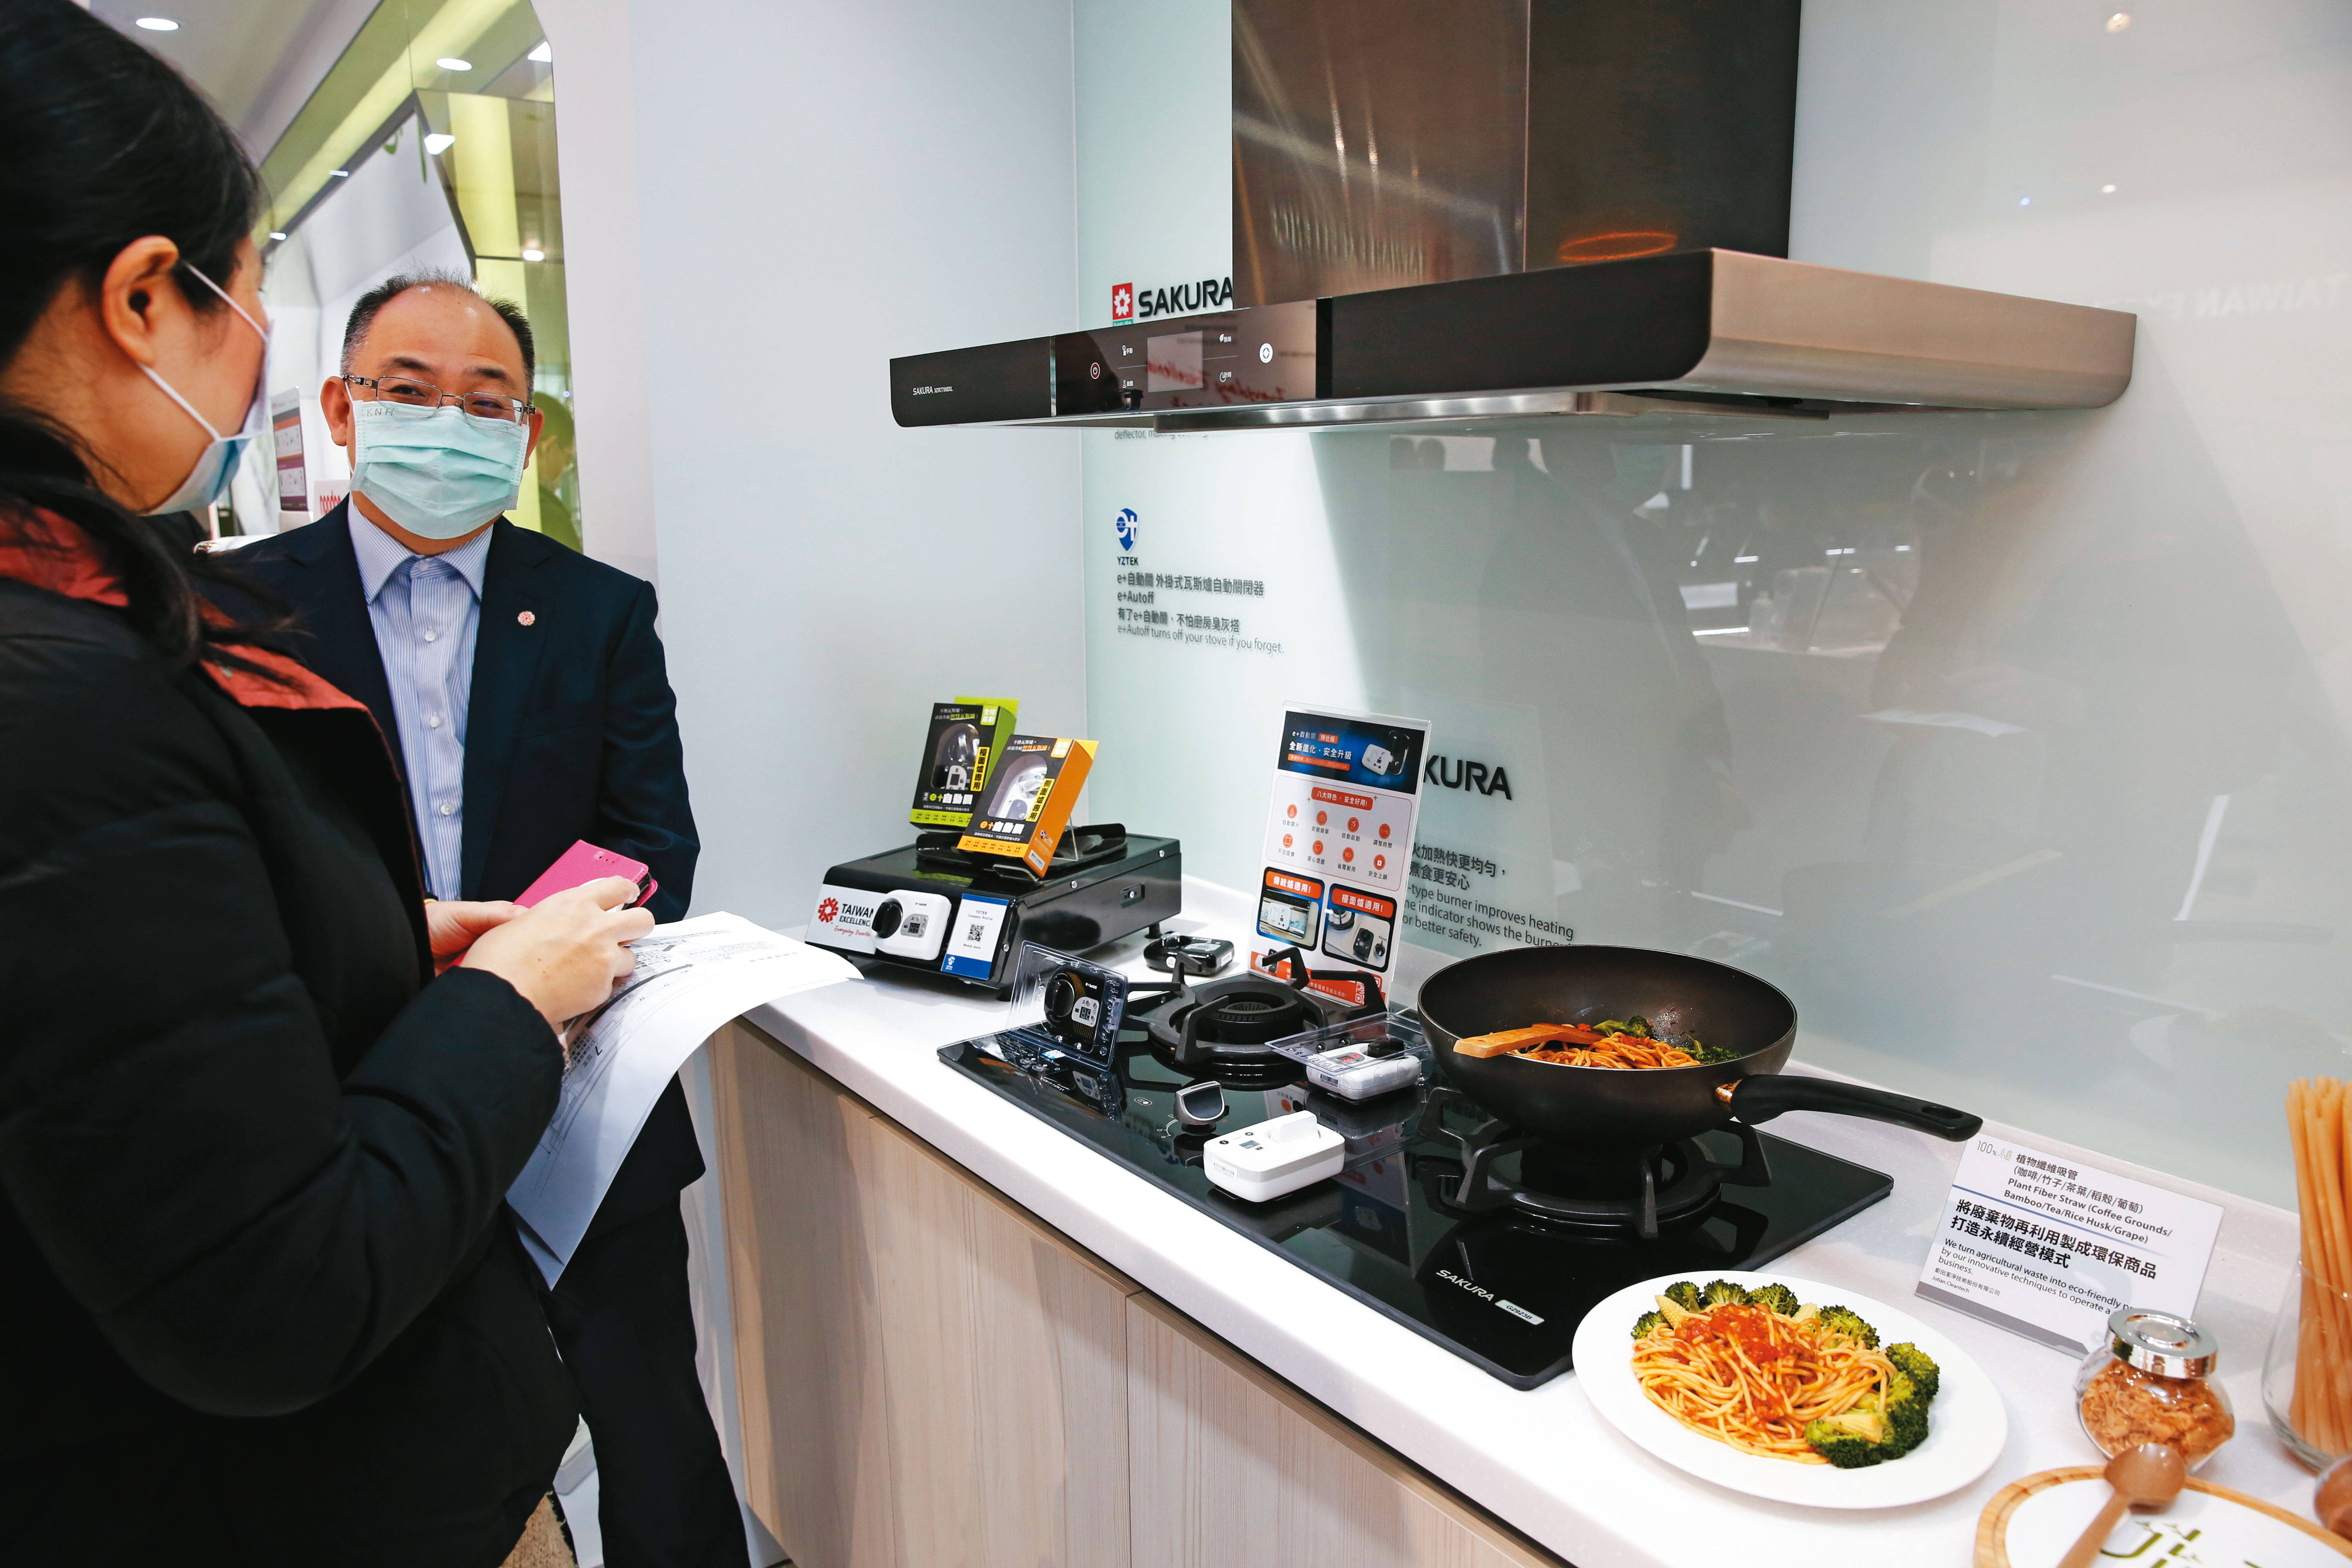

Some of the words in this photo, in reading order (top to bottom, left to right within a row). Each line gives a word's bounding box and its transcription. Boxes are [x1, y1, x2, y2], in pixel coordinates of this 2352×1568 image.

[1138, 277, 1233, 318] SAKURA
[913, 386, 933, 396] SAKURA
[1117, 556, 1138, 566] YZTEK
[1117, 590, 1155, 604] e+Autoff
[1118, 624, 1150, 636] e+Autoff
[1151, 628, 1170, 639] turns
[1173, 629, 1183, 640] off
[1185, 633, 1203, 644] your
[1205, 634, 1226, 646] stove
[1229, 635, 1235, 646] if
[1236, 638, 1252, 650] you
[1254, 638, 1284, 655] forget.
[1373, 840, 1392, 849] 調整時間
[1409, 861, 1470, 891] 煮食更安心
[1419, 901, 1464, 925] indicator
[1467, 915, 1501, 935] shows
[1503, 926, 1522, 941] the
[1437, 889, 1472, 910] burner
[1475, 900, 1526, 925] improves
[1529, 914, 1574, 941] heating
[1415, 916, 1446, 935] better
[1448, 928, 1482, 948] safety.
[1978, 1140, 1997, 1156] 100%
[2016, 1153, 2078, 1180] 植物纖維吸管
[2004, 1189, 2085, 1222] Bamboo/Tea/Rice
[2086, 1216, 2148, 1244] Husk/Grape)
[2008, 1178, 2031, 1192] Plant
[2034, 1186, 2057, 1200] Fiber
[2059, 1195, 2086, 1209] Straw
[2088, 1203, 2122, 1221] (Coffee
[2125, 1216, 2173, 1237] Grounds/
[1951, 1215, 2071, 1268] 打造永續經營模式
[1956, 1199, 2157, 1279] 將廢棄物再利用製成環保商品
[1938, 1256, 1973, 1274] business.
[1941, 1247, 1951, 1257] by
[1953, 1252, 1967, 1261] our
[1967, 1256, 2009, 1277] innovative
[2011, 1273, 2057, 1294] techniques
[2059, 1290, 2068, 1298] to
[2069, 1296, 2104, 1312] operate
[1945, 1238, 1957, 1248] We
[1959, 1244, 1975, 1254] turn
[1976, 1251, 2022, 1272] agricultural
[2024, 1268, 2048, 1281] waste
[2049, 1276, 2067, 1287] into
[2068, 1284, 2121, 1309] eco-friendly
[1436, 1270, 1494, 1301] SAKURA
[1506, 1305, 1533, 1320] G2923B
[1932, 1276, 1946, 1284] Jutian
[1947, 1281, 1969, 1293] Cleantech
